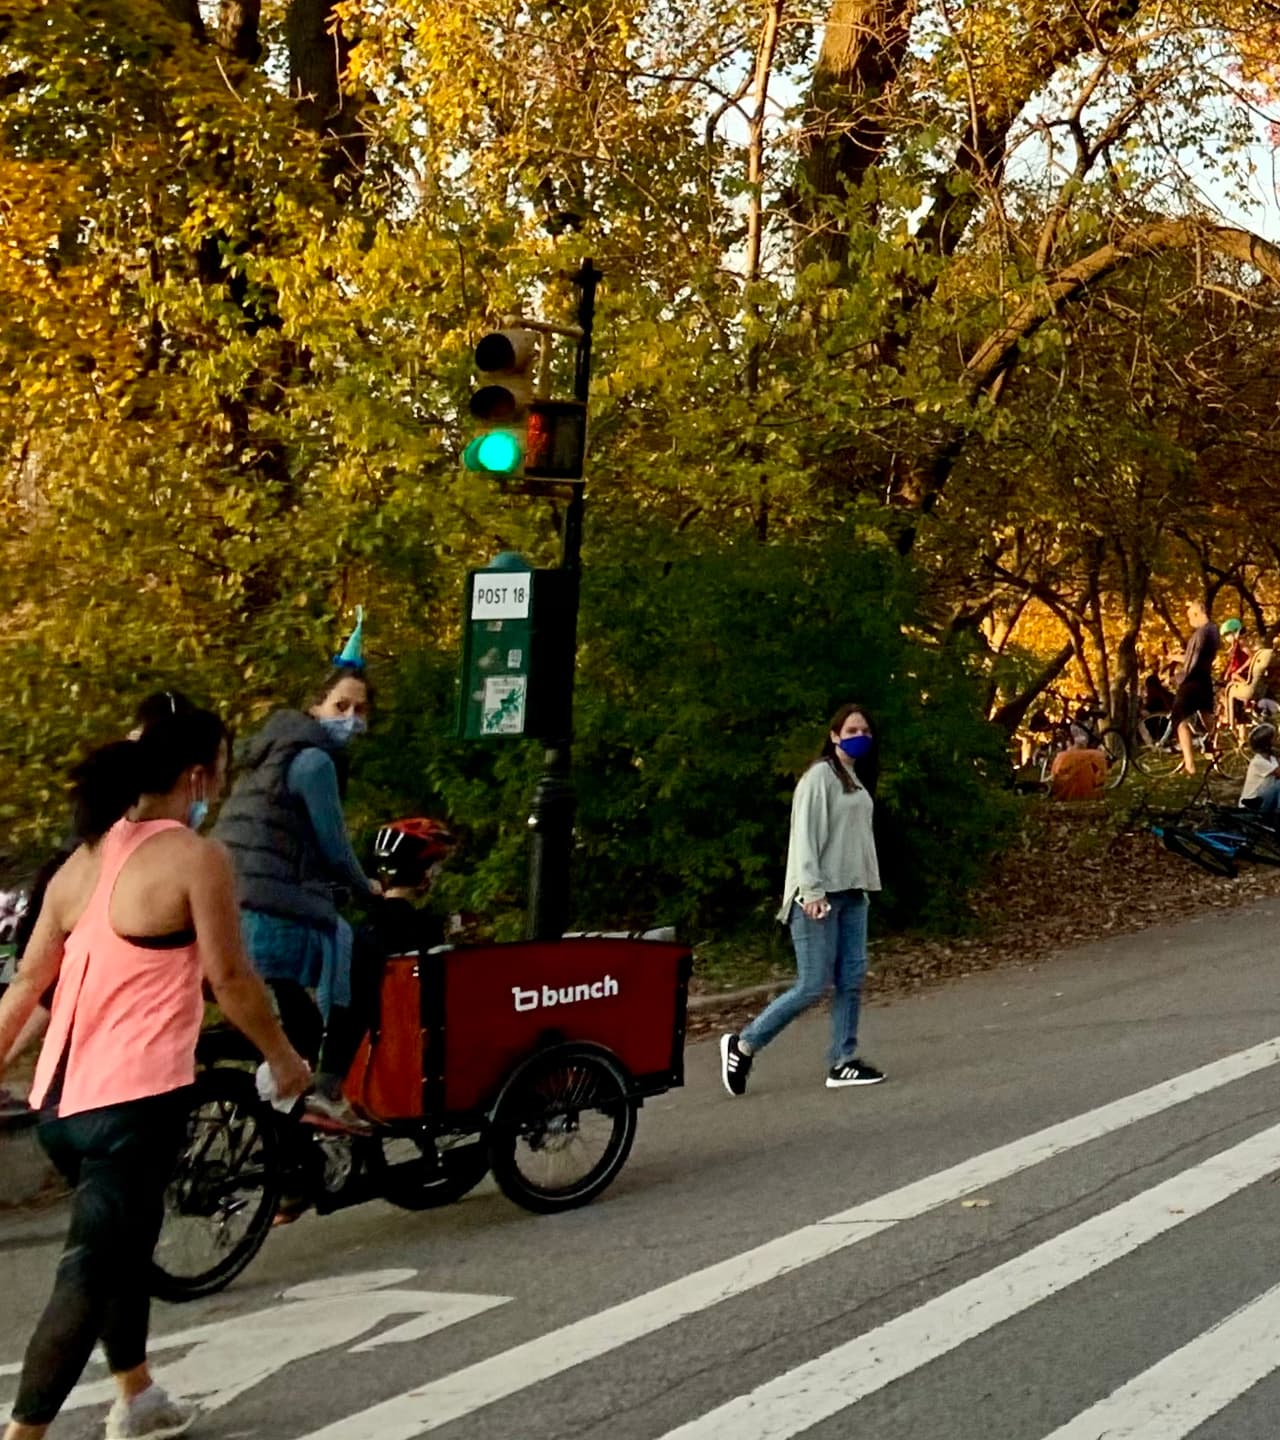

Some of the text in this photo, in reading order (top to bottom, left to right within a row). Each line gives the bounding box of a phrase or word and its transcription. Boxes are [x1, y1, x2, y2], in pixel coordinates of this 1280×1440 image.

[478, 587, 525, 604] POST 18
[542, 975, 618, 1007] bunch
